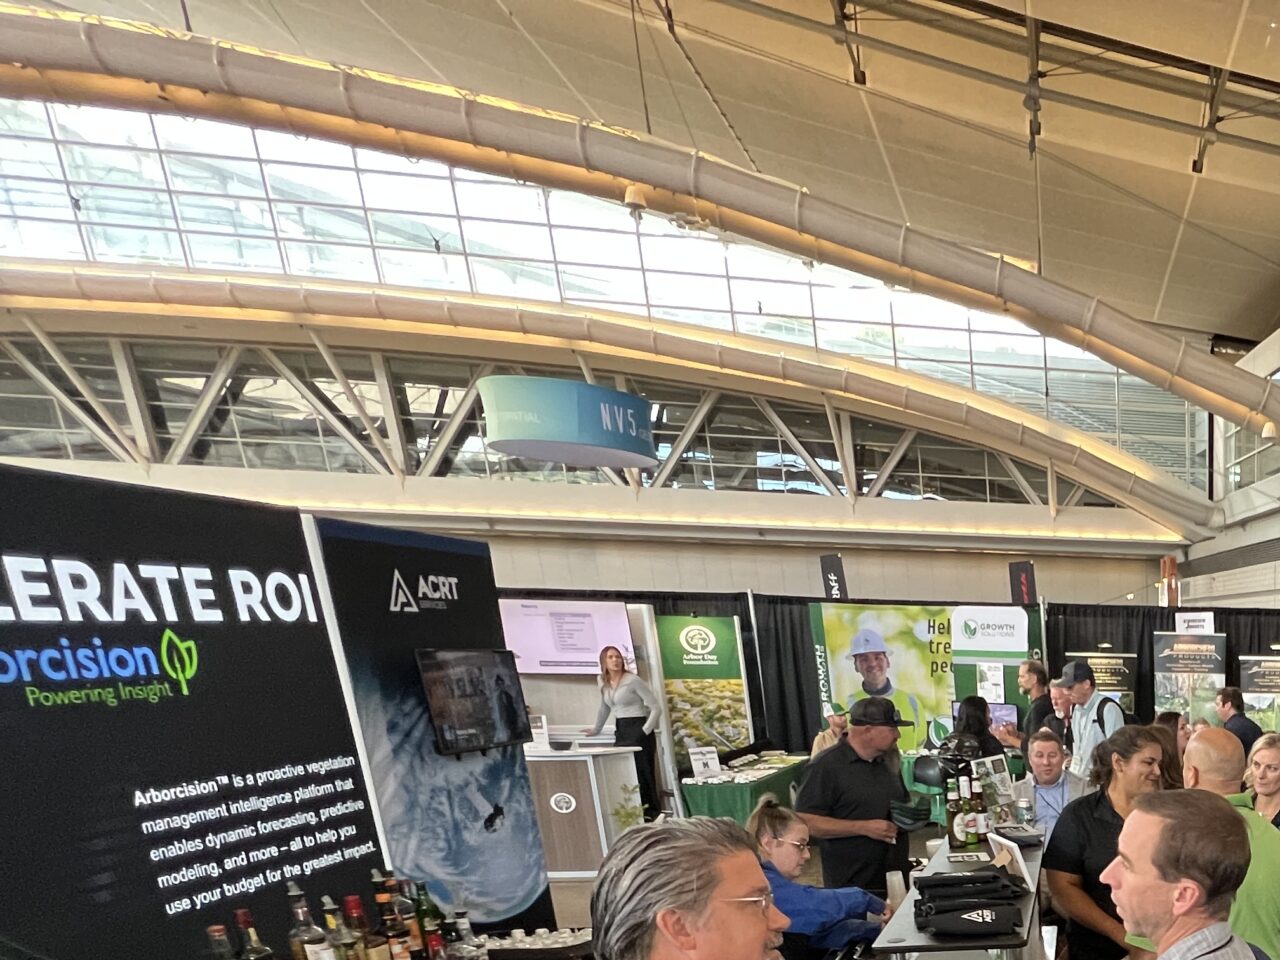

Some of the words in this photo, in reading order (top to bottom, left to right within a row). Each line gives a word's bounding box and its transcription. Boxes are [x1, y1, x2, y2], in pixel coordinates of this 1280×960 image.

[228, 569, 318, 623] ROI
[418, 575, 458, 600] ACRT
[980, 623, 1015, 631] GROWTH
[26, 684, 118, 707] Powering
[119, 679, 173, 703] Insight
[232, 773, 244, 788] is
[246, 774, 255, 785] a
[256, 763, 305, 786] proactive
[306, 755, 356, 775] vegetation
[142, 805, 229, 835] management
[229, 791, 292, 814] intelligence
[294, 782, 334, 803] platform
[335, 777, 354, 792] that
[150, 838, 204, 862] enables
[205, 824, 257, 849] dynamic
[257, 811, 319, 835] forecasting,
[320, 799, 365, 819] predictive
[157, 862, 222, 889] modeling,
[224, 856, 247, 870] and
[249, 846, 279, 862] more
[289, 838, 303, 852] all
[304, 834, 315, 847] to
[316, 828, 338, 845] help
[340, 824, 357, 842] you
[165, 899, 192, 915] use
[193, 888, 222, 910] your
[223, 874, 266, 897] budget
[266, 869, 282, 883] for
[283, 862, 302, 878] the
[303, 851, 344, 875] greatest
[344, 841, 377, 859] impact.
